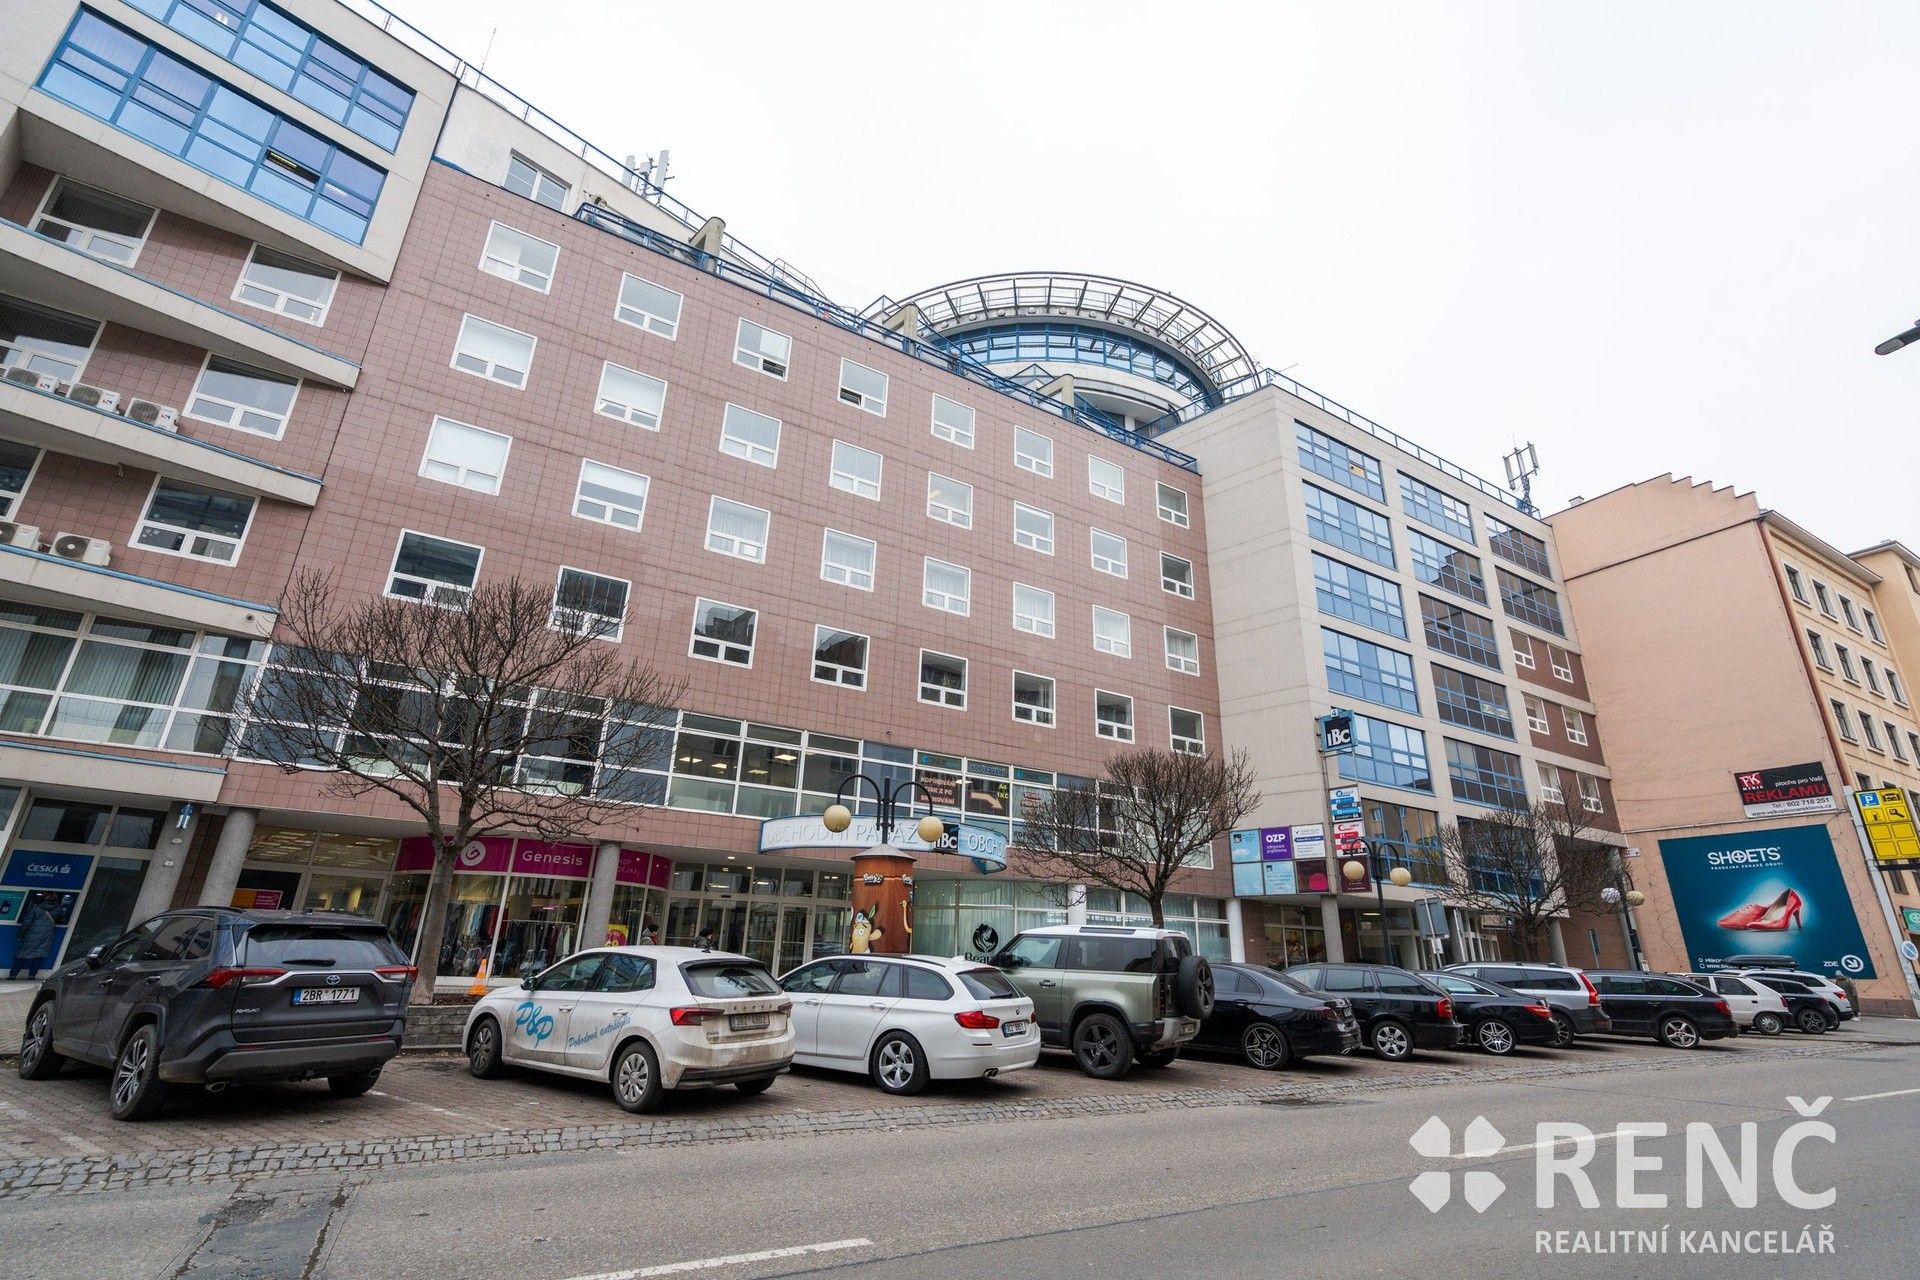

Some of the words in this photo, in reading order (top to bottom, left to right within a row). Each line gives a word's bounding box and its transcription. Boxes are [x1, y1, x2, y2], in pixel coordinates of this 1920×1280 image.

[1327, 729, 1350, 747] IBC
[1775, 779, 1797, 787] plocha
[1798, 777, 1809, 785] pro
[1744, 783, 1829, 802] REKLAMU
[856, 822, 918, 844] PAÁŽ
[1265, 833, 1286, 843] OZP
[522, 850, 583, 866] Genesis
[1707, 847, 1781, 865] SHOETS
[27, 863, 59, 873] ČESKÁ
[964, 952, 993, 963] Beau
[303, 989, 323, 1001] 2BR
[331, 988, 356, 1000] 1771
